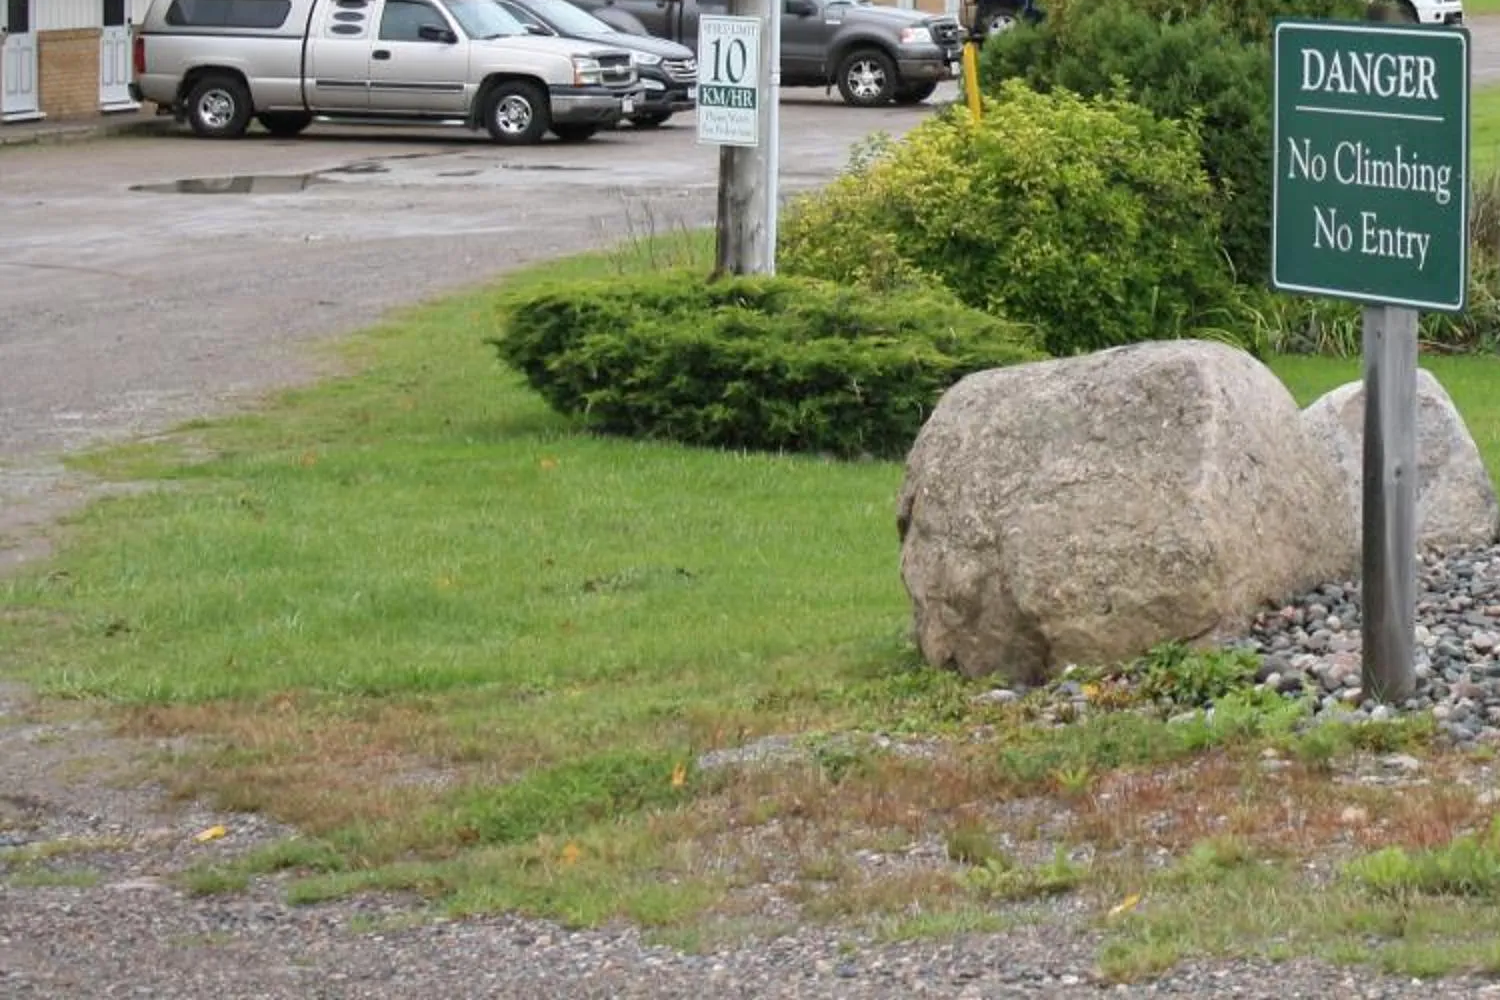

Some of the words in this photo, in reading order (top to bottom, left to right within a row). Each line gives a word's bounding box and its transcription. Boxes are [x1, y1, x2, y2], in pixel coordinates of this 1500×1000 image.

[711, 38, 747, 84] 10
[1301, 48, 1439, 100] DANGER
[703, 87, 753, 107] KM/HR
[1288, 137, 1327, 181] No
[1333, 140, 1451, 205] Climbing
[1313, 206, 1353, 252] No
[1360, 211, 1431, 271] Entry
